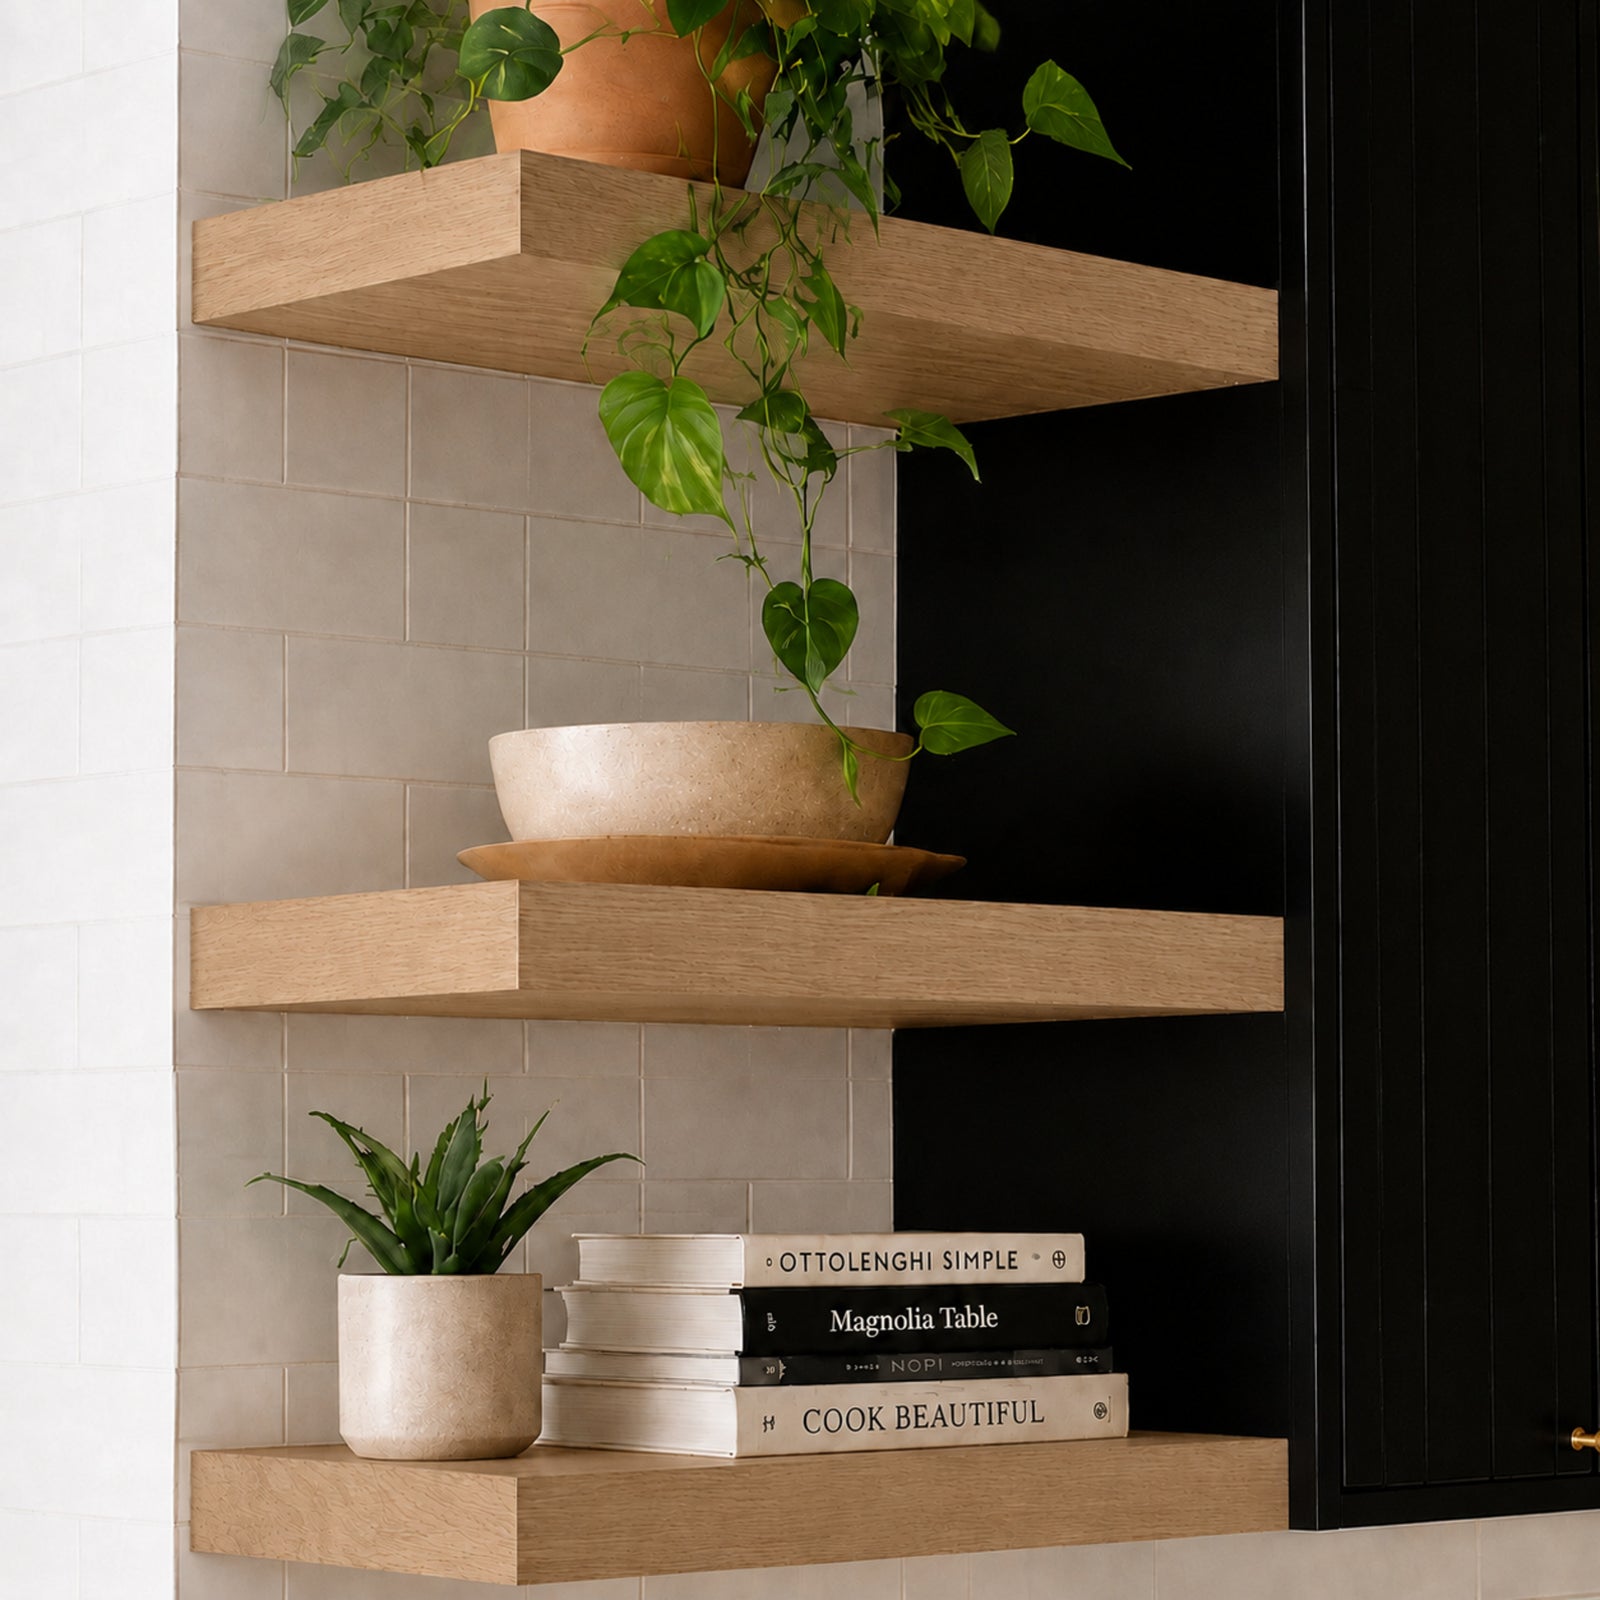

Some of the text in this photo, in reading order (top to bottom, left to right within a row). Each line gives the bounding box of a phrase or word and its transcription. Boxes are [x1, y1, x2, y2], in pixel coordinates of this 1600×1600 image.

[780, 1250, 1018, 1272] OTTOLENGHI SIMPLE
[830, 1304, 999, 1337] Magnolia Table
[891, 1358, 943, 1373] NOPI
[803, 1400, 1045, 1434] COOK BEAUTIFUL
